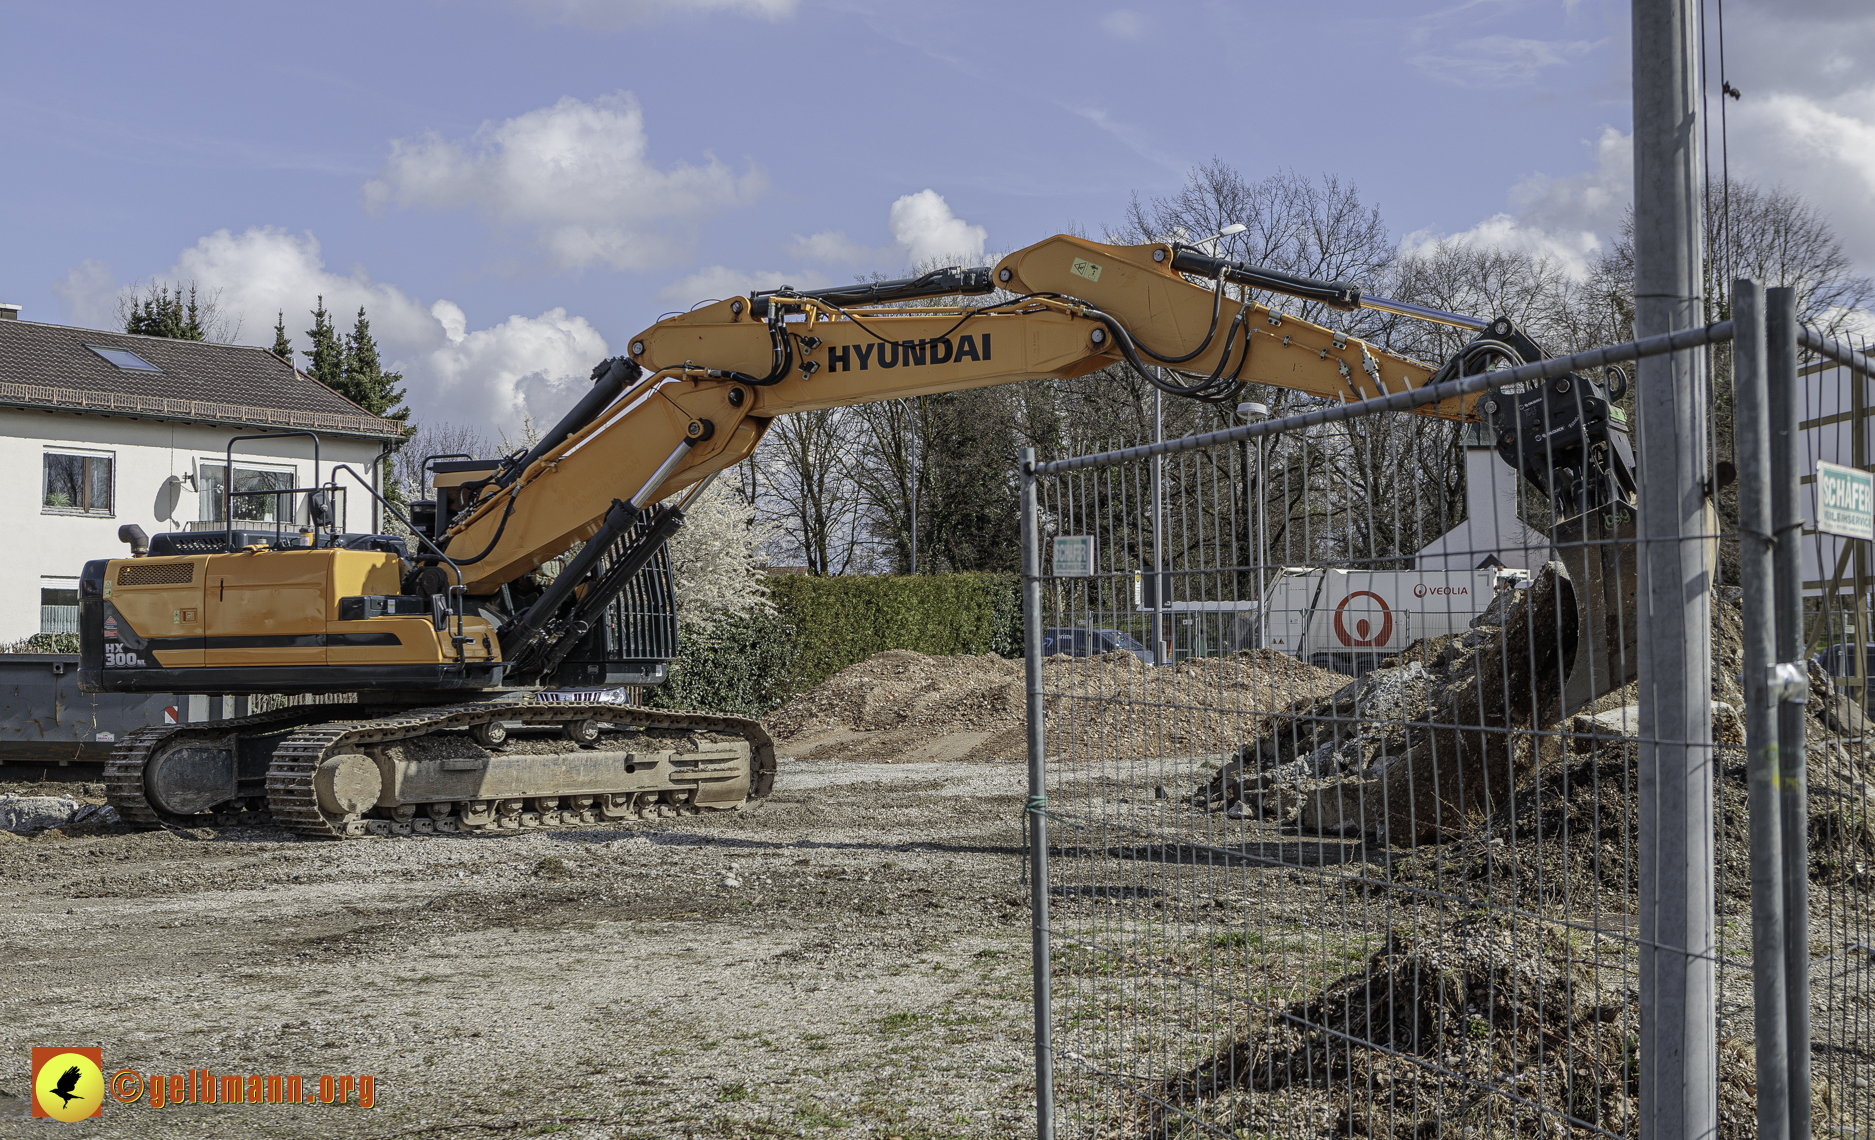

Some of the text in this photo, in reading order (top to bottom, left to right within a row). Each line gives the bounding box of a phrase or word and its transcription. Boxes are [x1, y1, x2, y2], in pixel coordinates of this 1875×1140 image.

[828, 333, 991, 373] HYUNDAI
[1429, 586, 1468, 595] VEOLIA
[105, 643, 124, 653] HX
